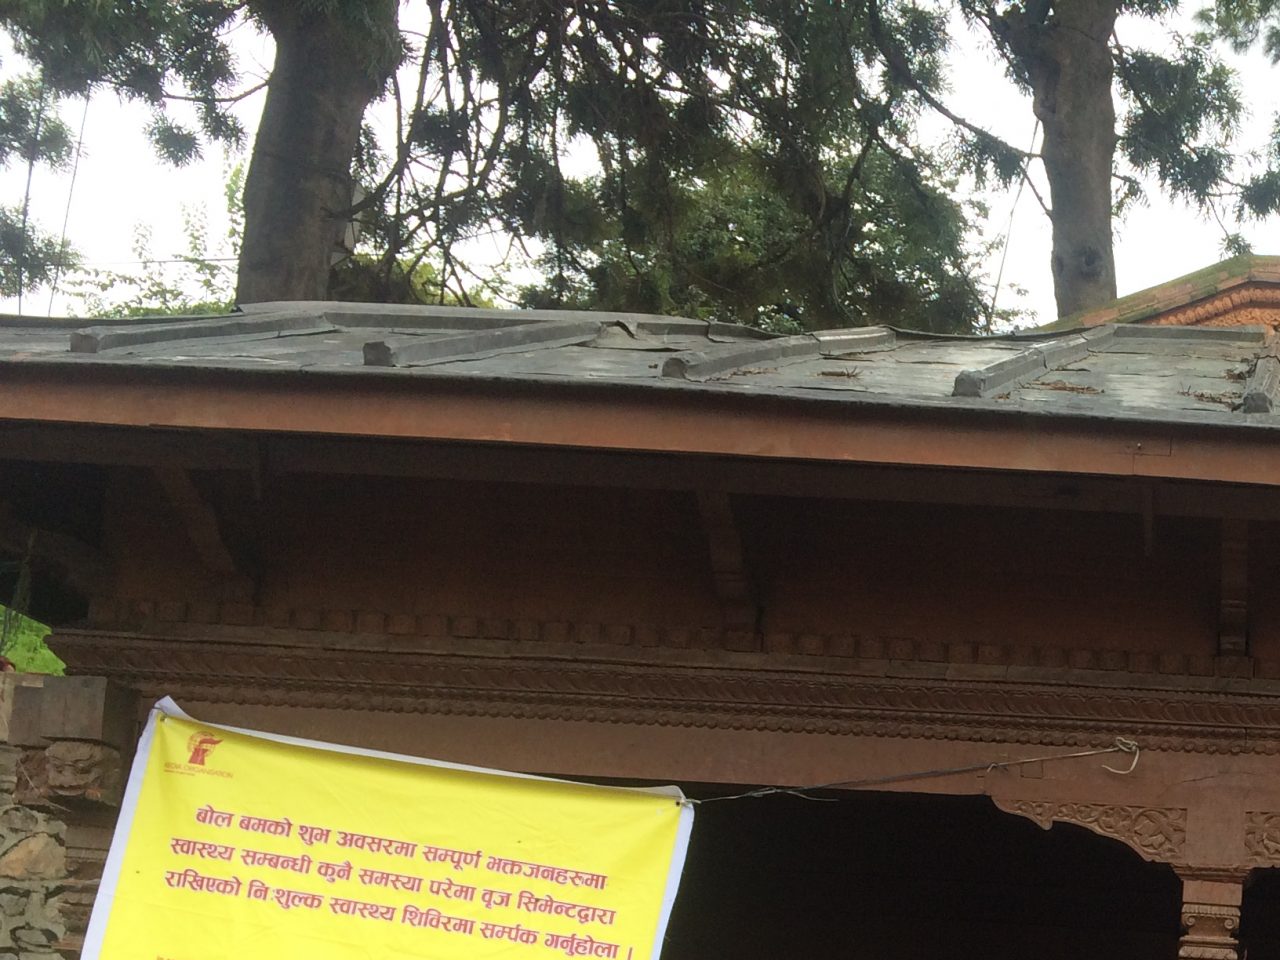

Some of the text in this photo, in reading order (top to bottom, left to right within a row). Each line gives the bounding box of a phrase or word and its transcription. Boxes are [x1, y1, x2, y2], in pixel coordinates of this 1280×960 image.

[170, 837, 617, 925] स्वास्थ्य सम्बन्धी कुनै समस्या परेमा वृज सिमेन्टद्वारा
[196, 804, 234, 828] बोल
[239, 815, 293, 838] बमको
[298, 824, 332, 846] शुभ
[336, 830, 418, 859] अवसरमा
[422, 845, 482, 871] सम्पूर्ण
[164, 868, 242, 896] राखिएको
[329, 897, 397, 921] स्वास्थ्य
[401, 905, 476, 935] शिविरमा
[544, 933, 620, 959] गर्नुहोला
